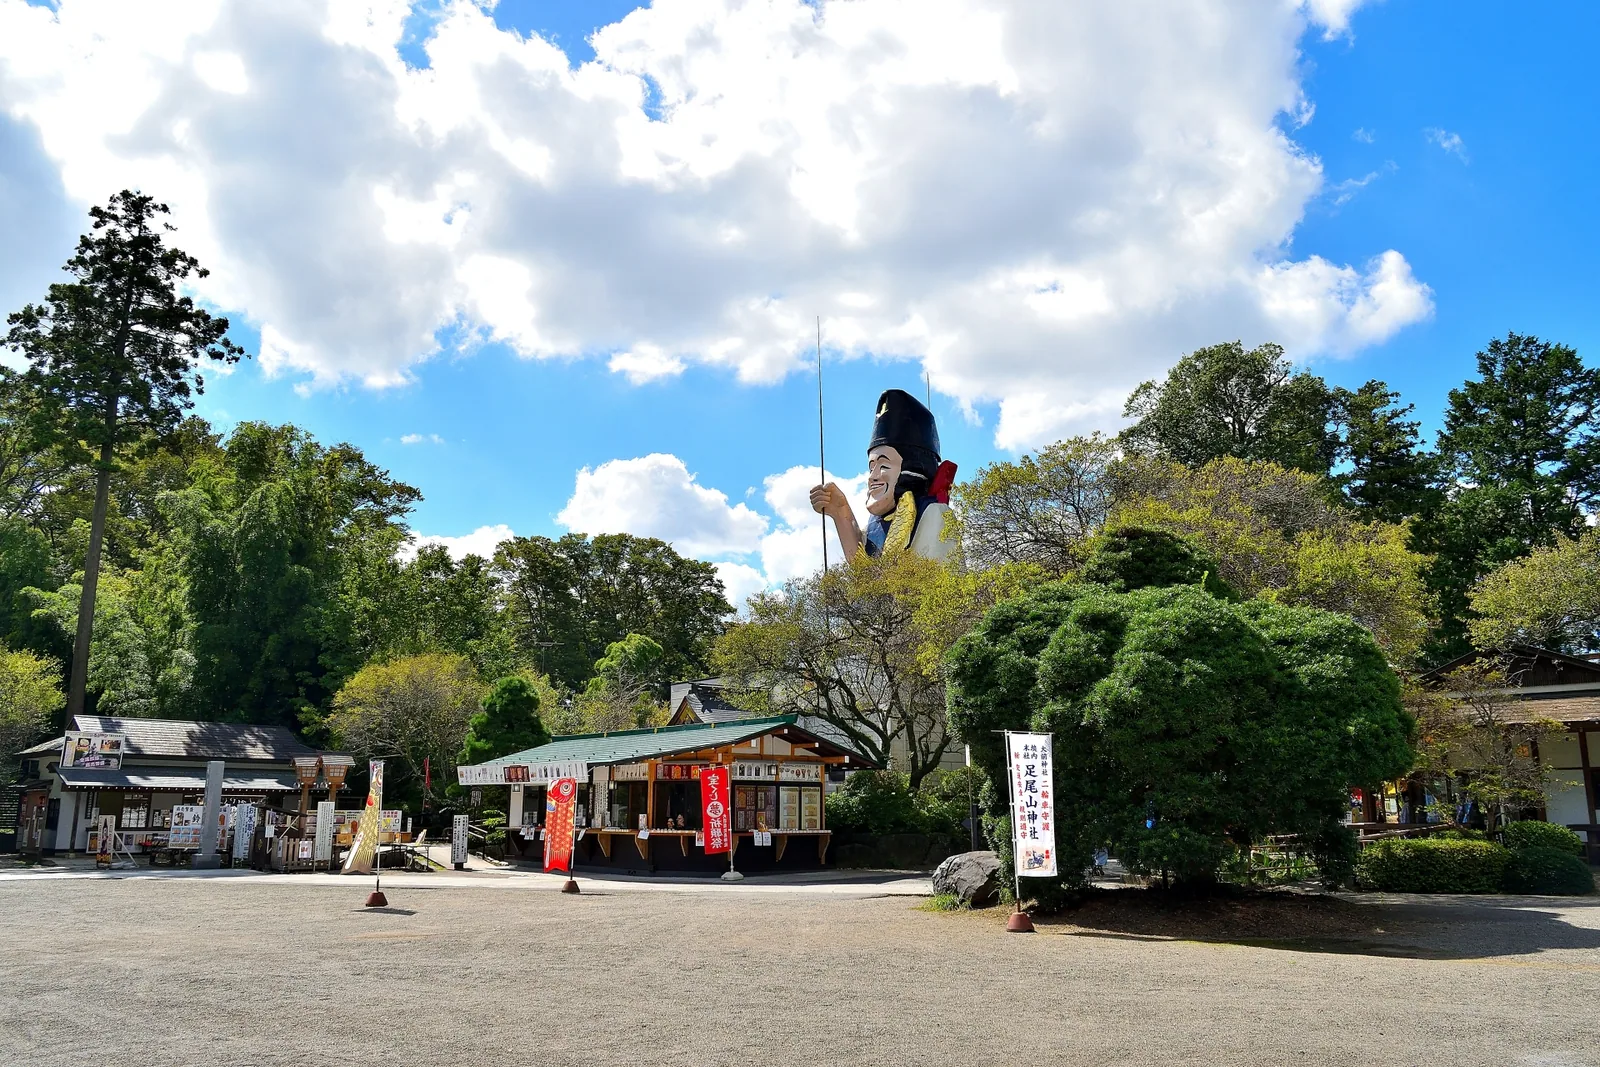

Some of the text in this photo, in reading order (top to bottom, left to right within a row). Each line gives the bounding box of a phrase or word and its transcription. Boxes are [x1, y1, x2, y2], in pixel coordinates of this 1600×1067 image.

[1024, 764, 1039, 840] 足尾山神社
[1041, 780, 1050, 831] 二輪車守護
